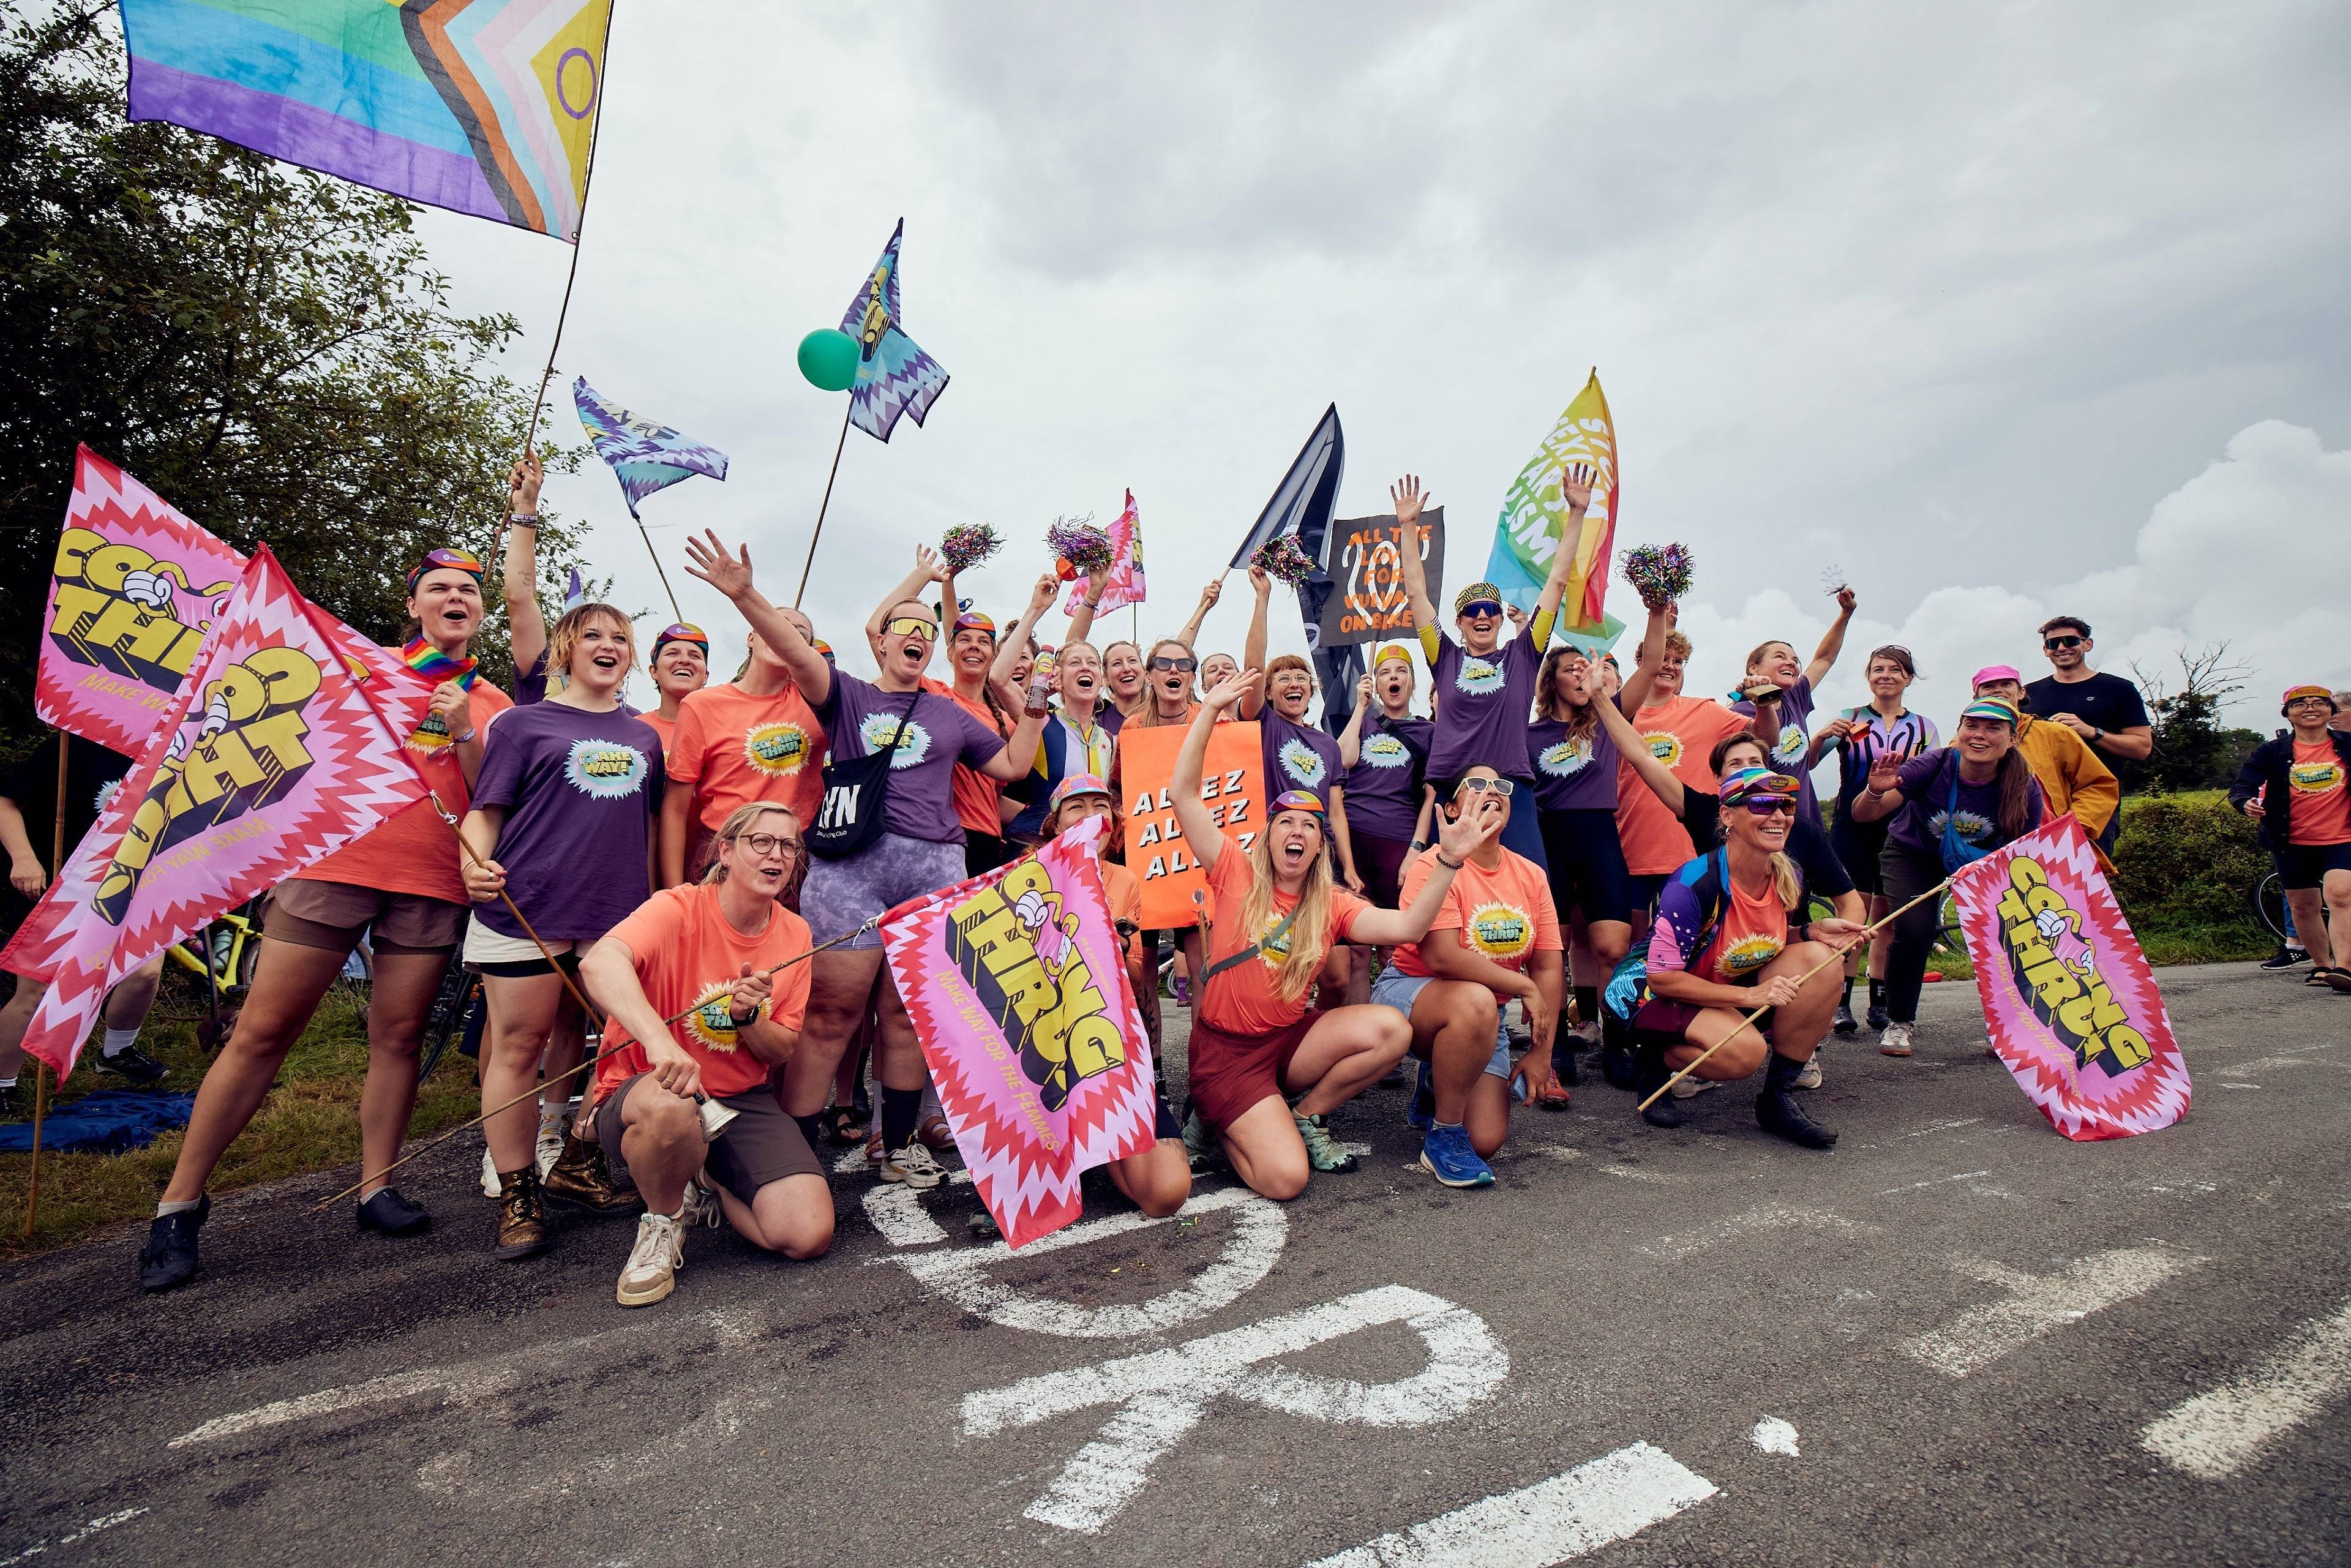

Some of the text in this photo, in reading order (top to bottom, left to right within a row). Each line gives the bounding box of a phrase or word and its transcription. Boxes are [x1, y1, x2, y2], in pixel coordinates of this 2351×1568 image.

[1579, 418, 1614, 493] STO
[1389, 525, 1433, 544] TE
[1360, 546, 1402, 567] LOV
[1340, 614, 1368, 634] ON
[77, 673, 168, 711] MAKE WA
[584, 761, 630, 777] WAY!
[1132, 769, 1245, 816] ALEZ
[1139, 798, 1250, 848] ALEZ
[1144, 831, 1258, 881] ALZ
[1480, 928, 1520, 943] THRU!
[1995, 953, 2010, 983] MAKE
[2004, 986, 2022, 1011] WAY
[2015, 1011, 2039, 1032] FOR
[2034, 1033, 2060, 1052] THE
[934, 970, 1060, 1150] MAKE WAY FOR THE FEMMES
